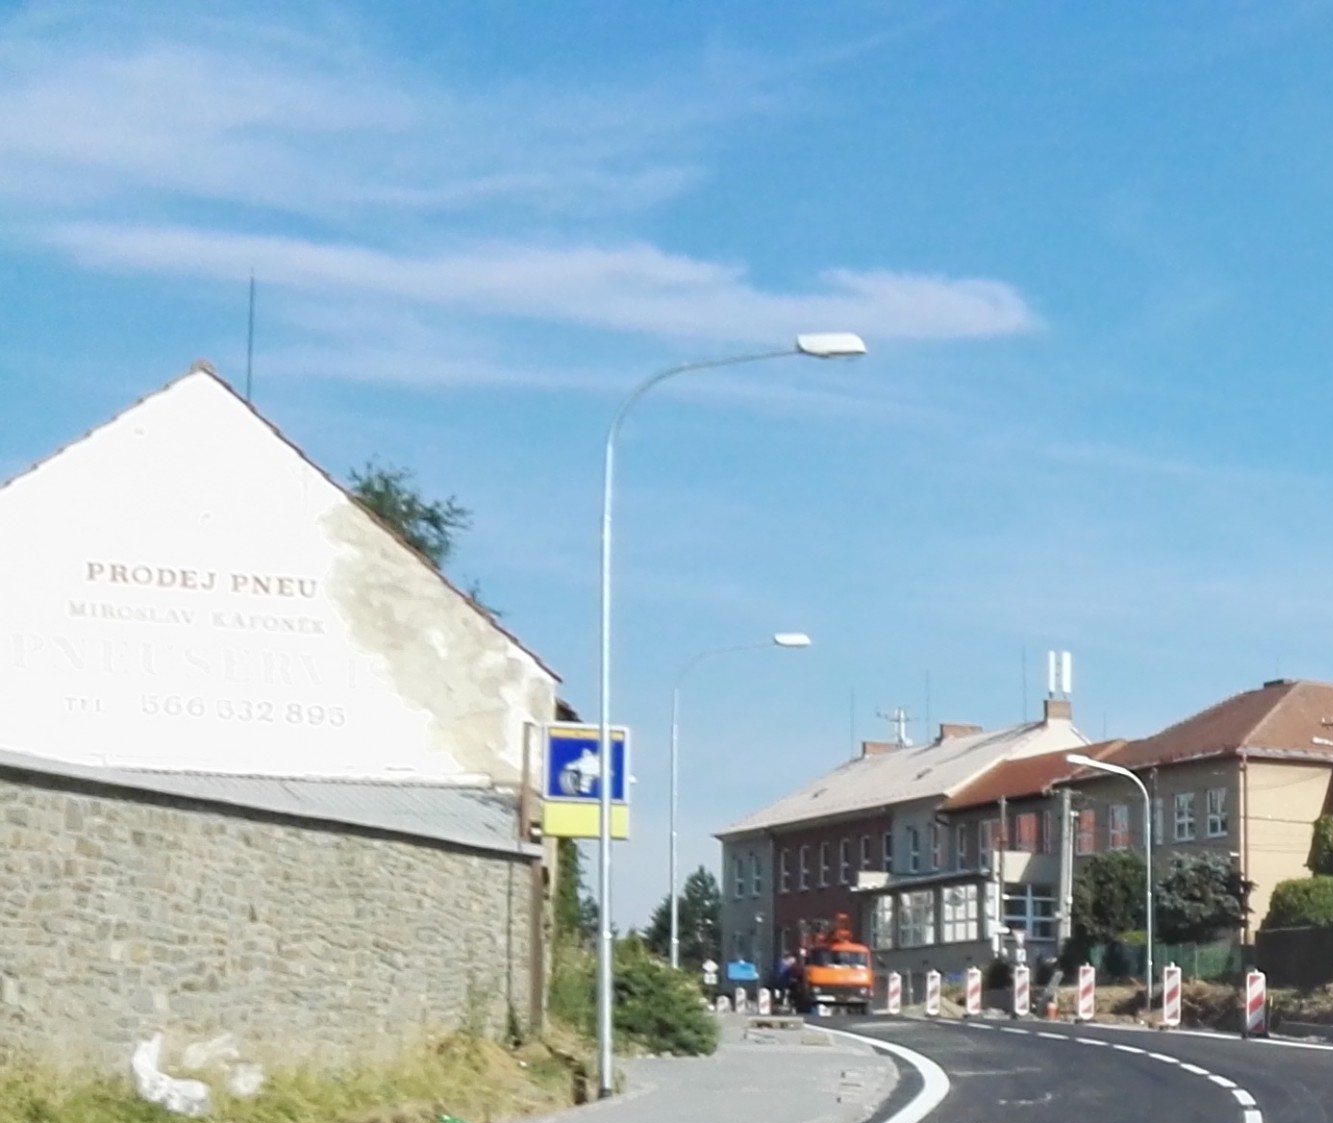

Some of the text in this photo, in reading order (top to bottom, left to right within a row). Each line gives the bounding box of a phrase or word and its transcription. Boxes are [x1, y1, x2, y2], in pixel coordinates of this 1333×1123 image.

[86, 561, 318, 599] PRODEJ PNEU
[68, 600, 196, 625] MIROSLAV
[141, 694, 206, 718] 566
[285, 702, 347, 728] 895
